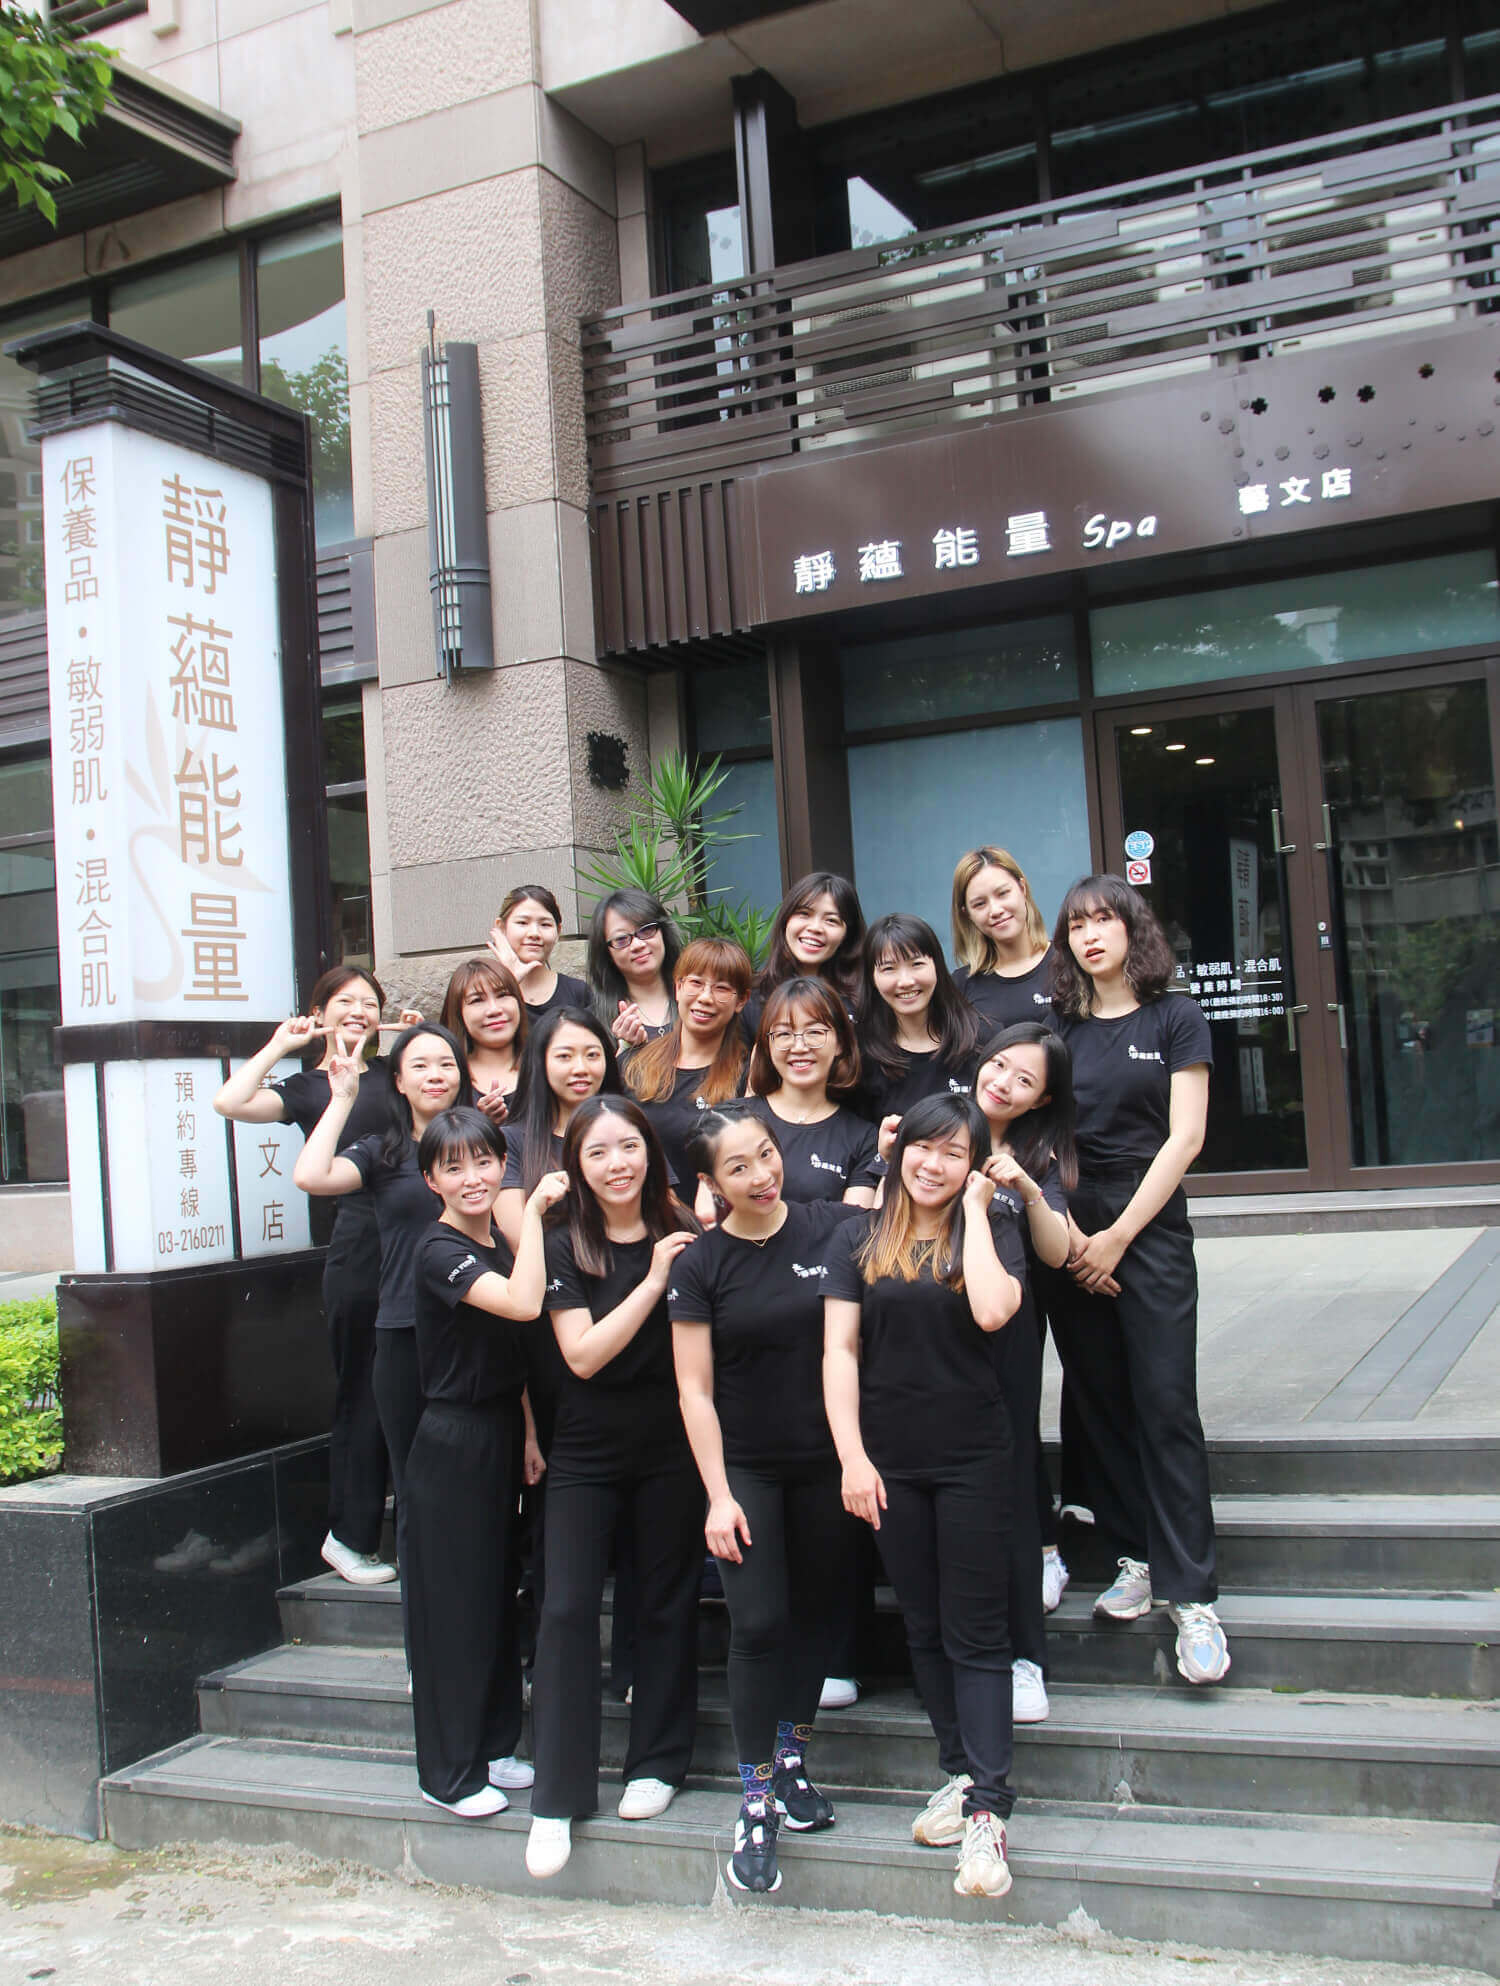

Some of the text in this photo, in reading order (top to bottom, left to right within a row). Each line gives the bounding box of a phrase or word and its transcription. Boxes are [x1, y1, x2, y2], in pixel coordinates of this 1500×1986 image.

[1237, 468, 1353, 516] 藝文店
[793, 511, 1158, 594] 靜蘊能量 Spa
[162, 473, 249, 1001] 靜蘊能量
[174, 1072, 201, 1218] 預約專線
[257, 1073, 284, 1241] 文店
[158, 1223, 226, 1255] 03-2160211
